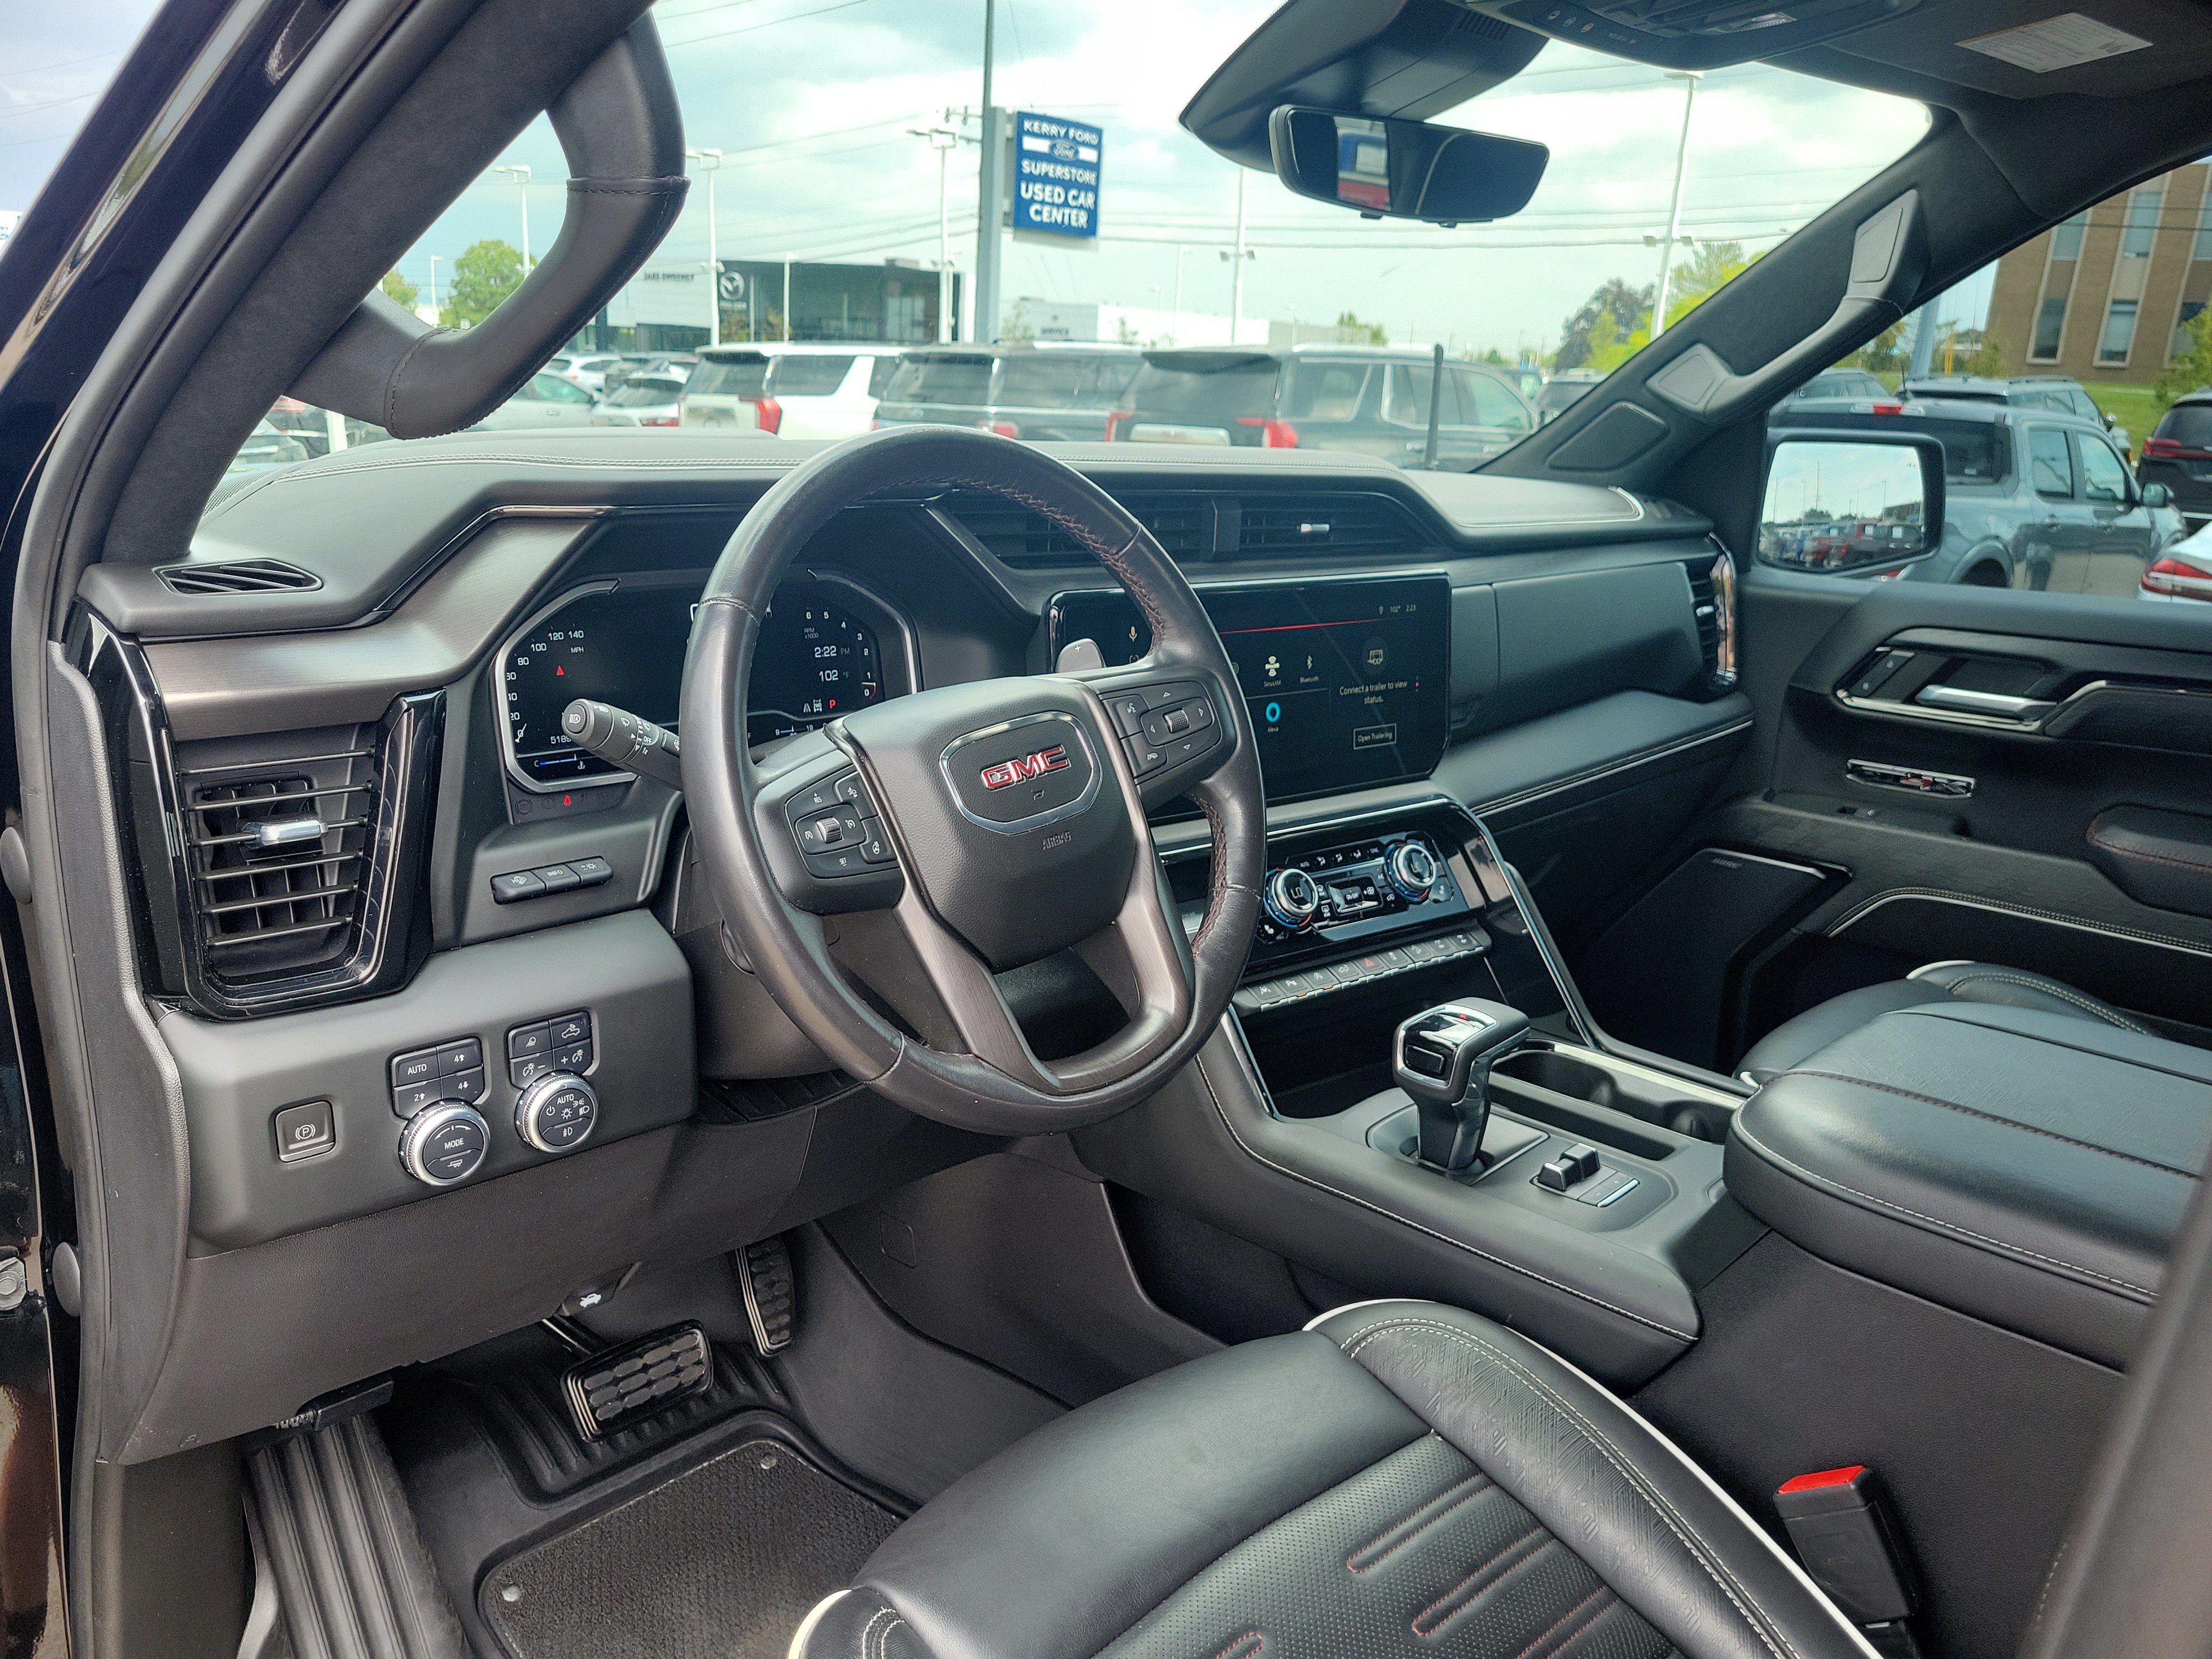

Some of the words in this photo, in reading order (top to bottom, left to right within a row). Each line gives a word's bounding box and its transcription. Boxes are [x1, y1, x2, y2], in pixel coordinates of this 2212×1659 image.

[1023, 119, 1068, 138] KERRY
[1068, 127, 1099, 145] FORD
[1021, 158, 1097, 186] SUPERSTORE
[1020, 180, 1066, 205] USED
[1067, 188, 1096, 210] CAR
[1029, 202, 1089, 229] CENTER
[823, 611, 829, 619] 5
[841, 621, 846, 629] 4
[548, 632, 564, 641] 120
[568, 630, 584, 639] 140
[857, 633, 862, 641] 3
[531, 643, 547, 652] 100
[814, 645, 837, 658] 2:22
[864, 648, 869, 656] 2
[517, 657, 529, 665] 80
[819, 669, 839, 682] 102
[864, 689, 870, 697] 0
[1339, 685, 1364, 695] Connect
[1370, 682, 1386, 692] trailer
[1387, 681, 1394, 690] to
[829, 699, 836, 709] P
[1364, 695, 1384, 704] status.
[643, 736, 652, 744] OFF
[1358, 734, 1371, 743] Open
[1372, 731, 1392, 741] Trailering
[981, 744, 1072, 792] GMC
[1043, 830, 1072, 850] AIRBAG
[839, 857, 847, 865] SET
[546, 869, 564, 877] INFO
[407, 1063, 427, 1075] AUTO
[557, 1093, 574, 1105] AUTO
[444, 1137, 465, 1150] MODE
